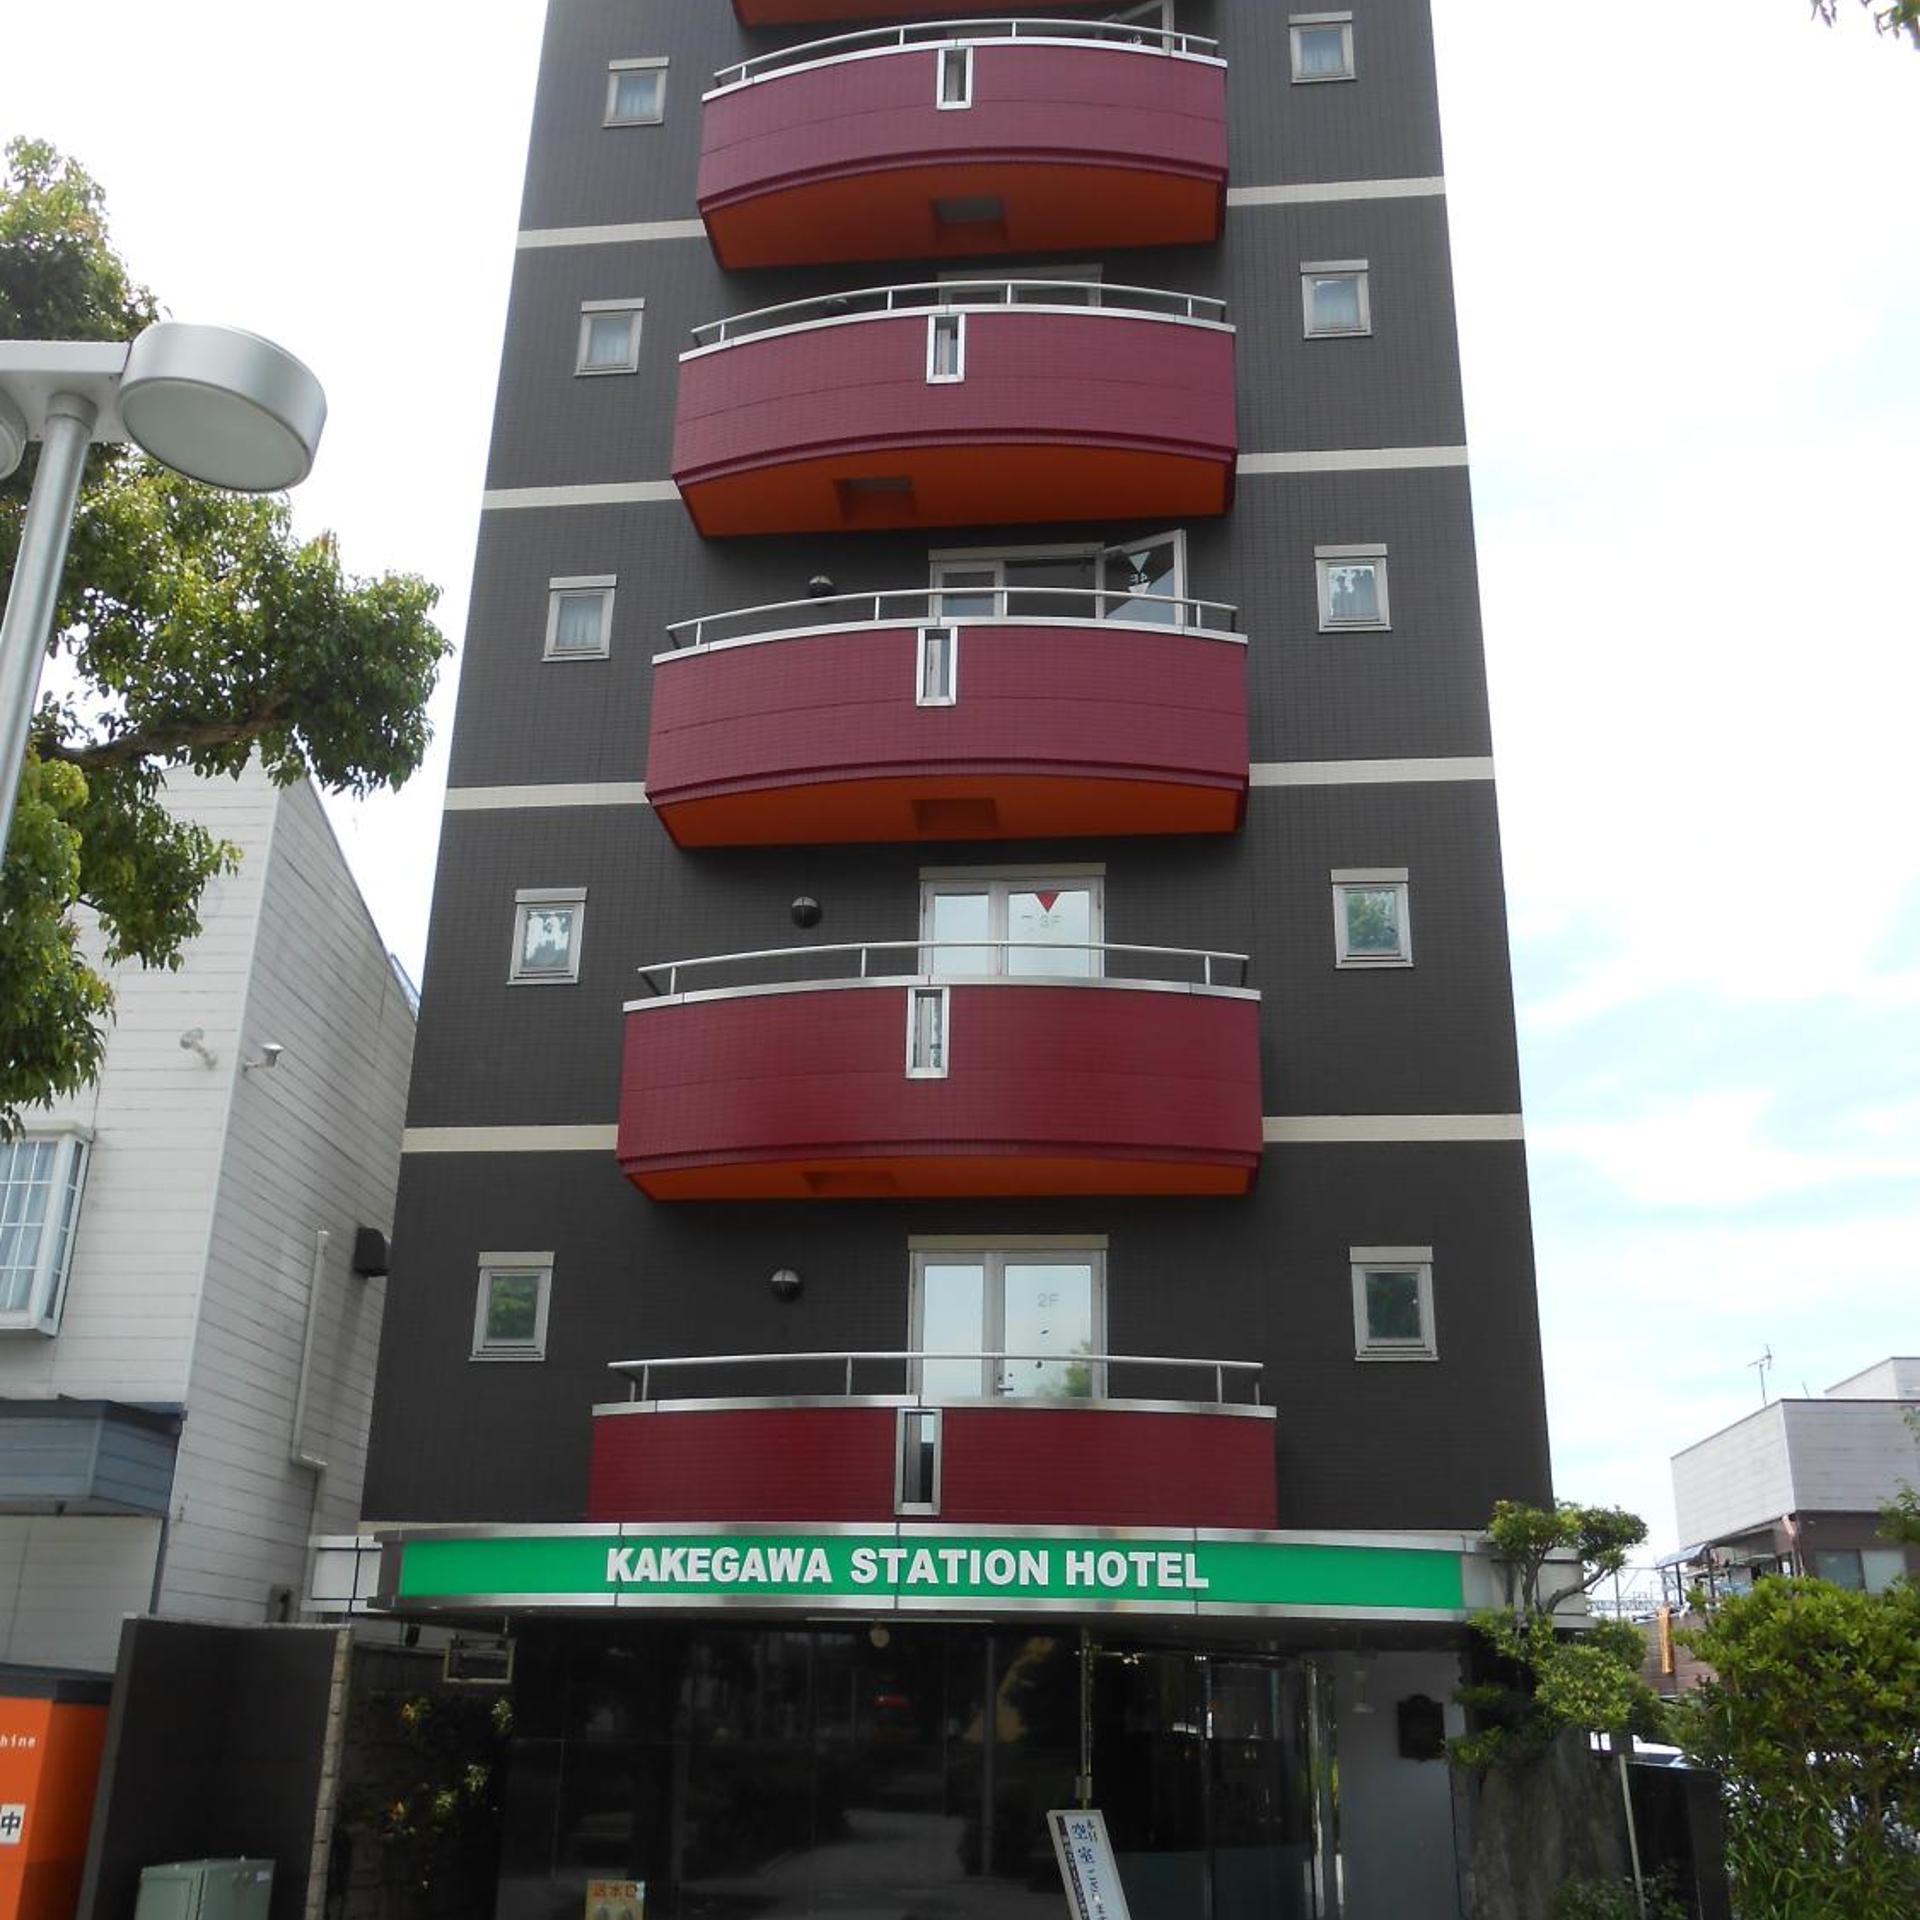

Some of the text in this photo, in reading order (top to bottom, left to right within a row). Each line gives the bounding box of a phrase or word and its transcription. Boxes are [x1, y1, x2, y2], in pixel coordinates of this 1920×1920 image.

[1036, 1292, 1060, 1308] 2F
[606, 1547, 1209, 1588] KAKEGAWA STATION HOTEL
